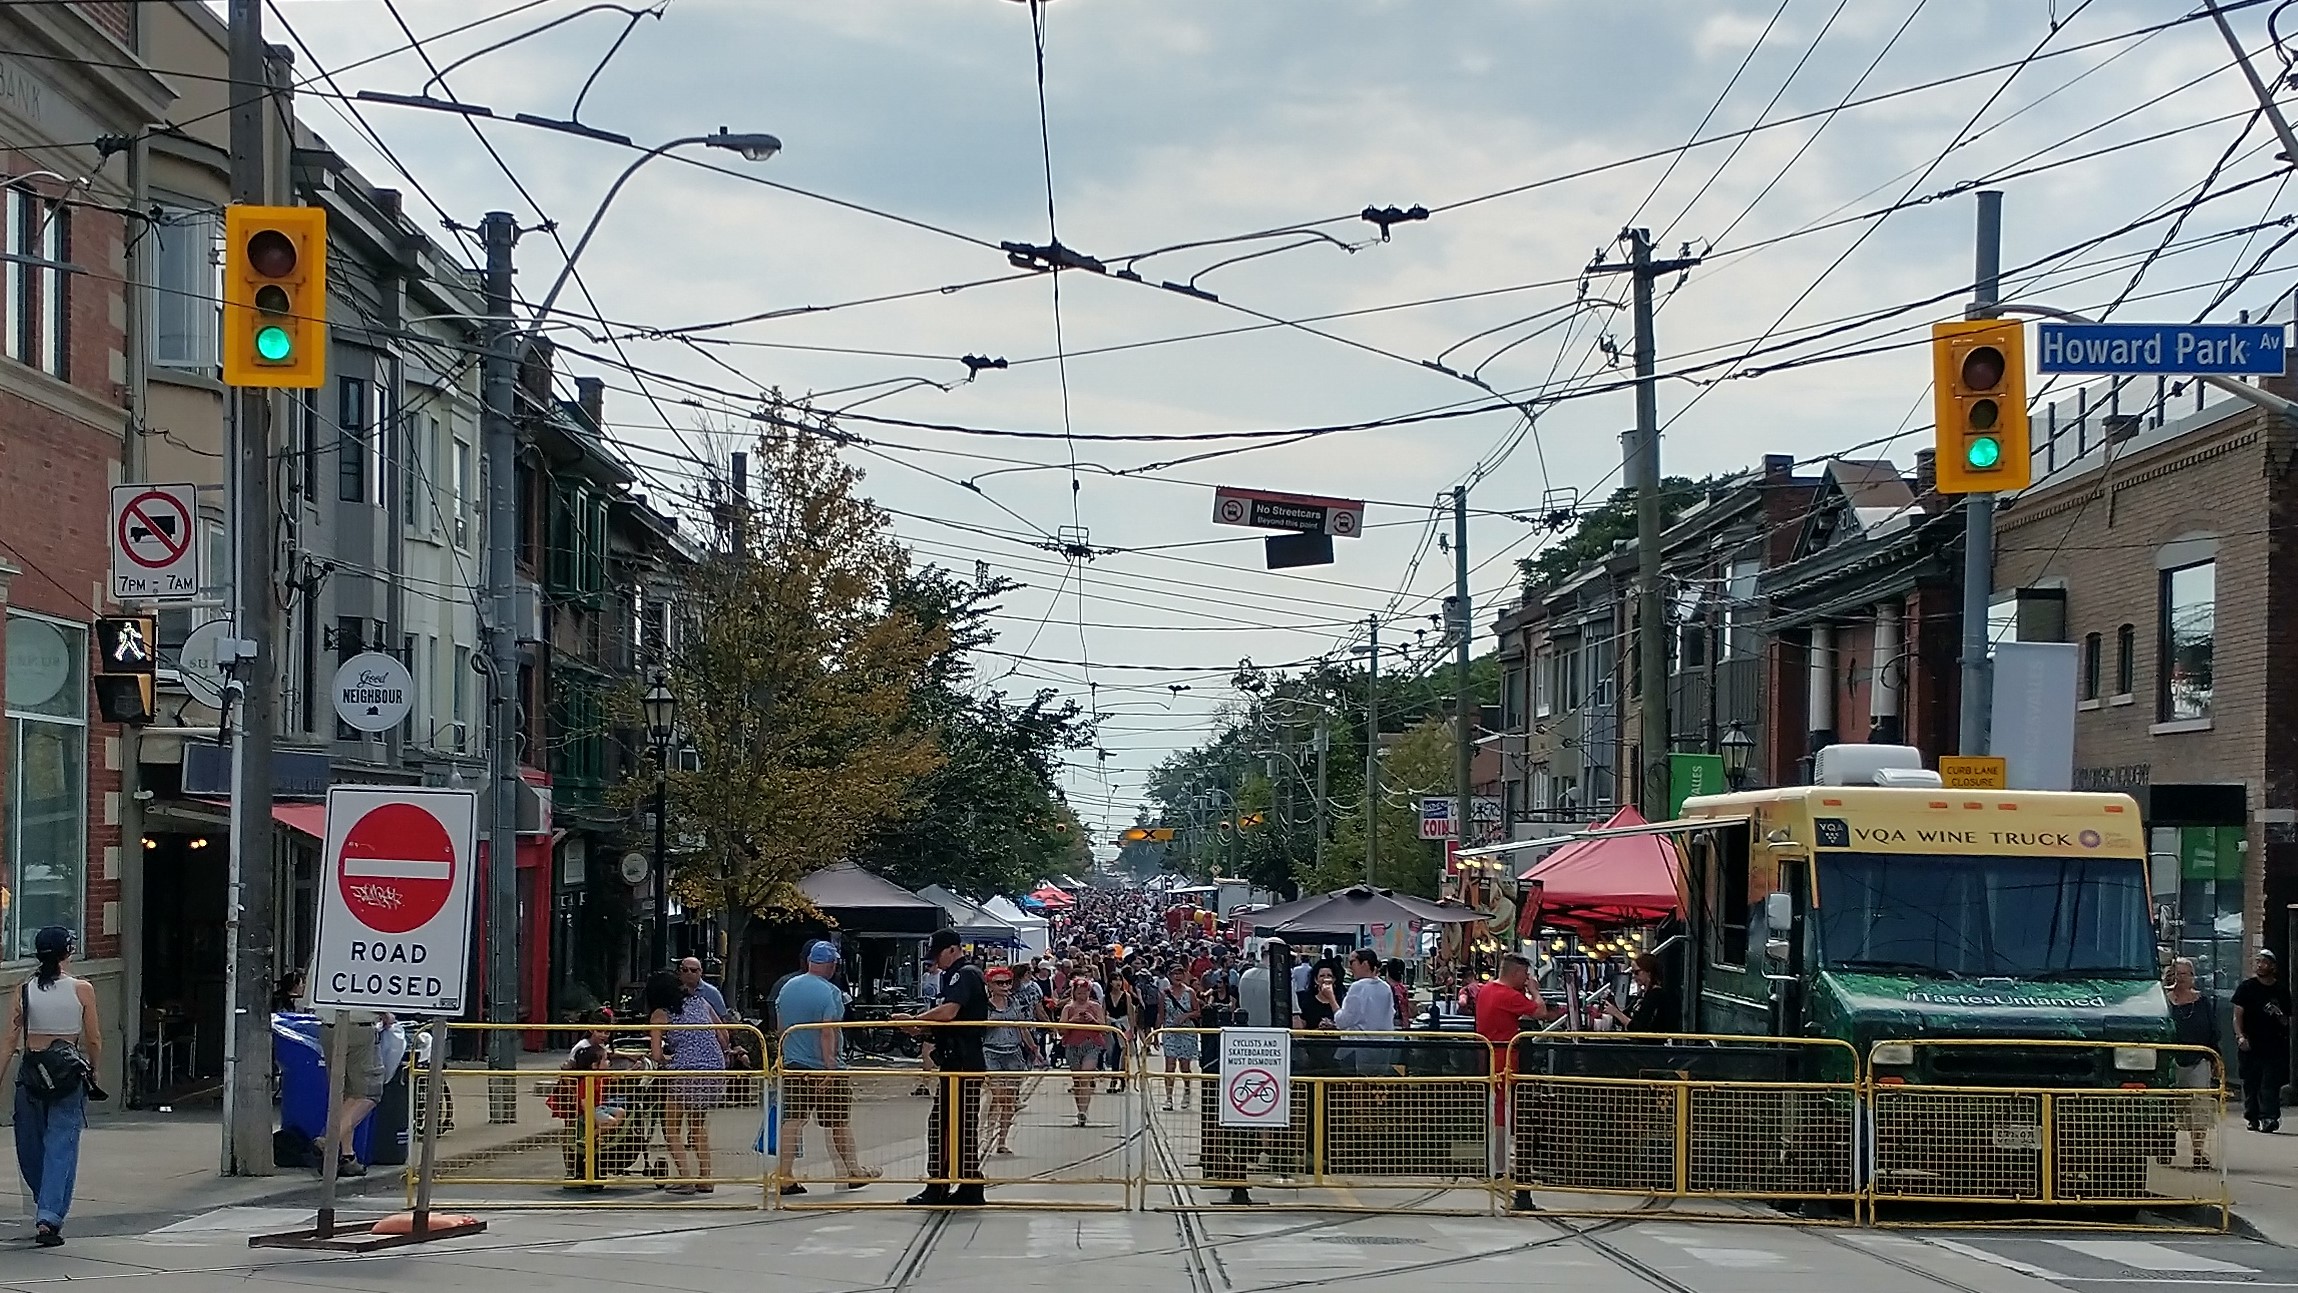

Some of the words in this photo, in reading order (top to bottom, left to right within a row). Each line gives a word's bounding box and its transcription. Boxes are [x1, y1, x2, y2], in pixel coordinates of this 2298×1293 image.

[2044, 332, 2161, 364] Howard
[2177, 332, 2247, 364] Park
[2259, 332, 2280, 350] Av
[1257, 504, 1270, 514] No
[1272, 506, 1321, 519] Streetcars
[1257, 516, 1285, 526] Beyond
[1286, 519, 1298, 527] this
[1300, 520, 1318, 529] point
[119, 576, 146, 592] 7PM
[166, 574, 193, 590] 7AM
[357, 669, 390, 688] Good
[342, 688, 403, 704] NEIGHBOUR
[1947, 766, 1972, 775] CURB
[1974, 766, 1998, 775] LANE
[1951, 778, 1994, 787] CLOSURE
[1424, 819, 1449, 836] COIN
[1818, 823, 1843, 832] VQA
[1855, 828, 1906, 844] VQA
[1917, 830, 1977, 844] WINE
[1989, 832, 2072, 846] TRUCK
[351, 941, 427, 963] ROAD
[332, 972, 442, 997] CLOSED
[1906, 992, 2106, 1007] #TastesUntamed
[1232, 1039, 1261, 1047] CYCLISTS
